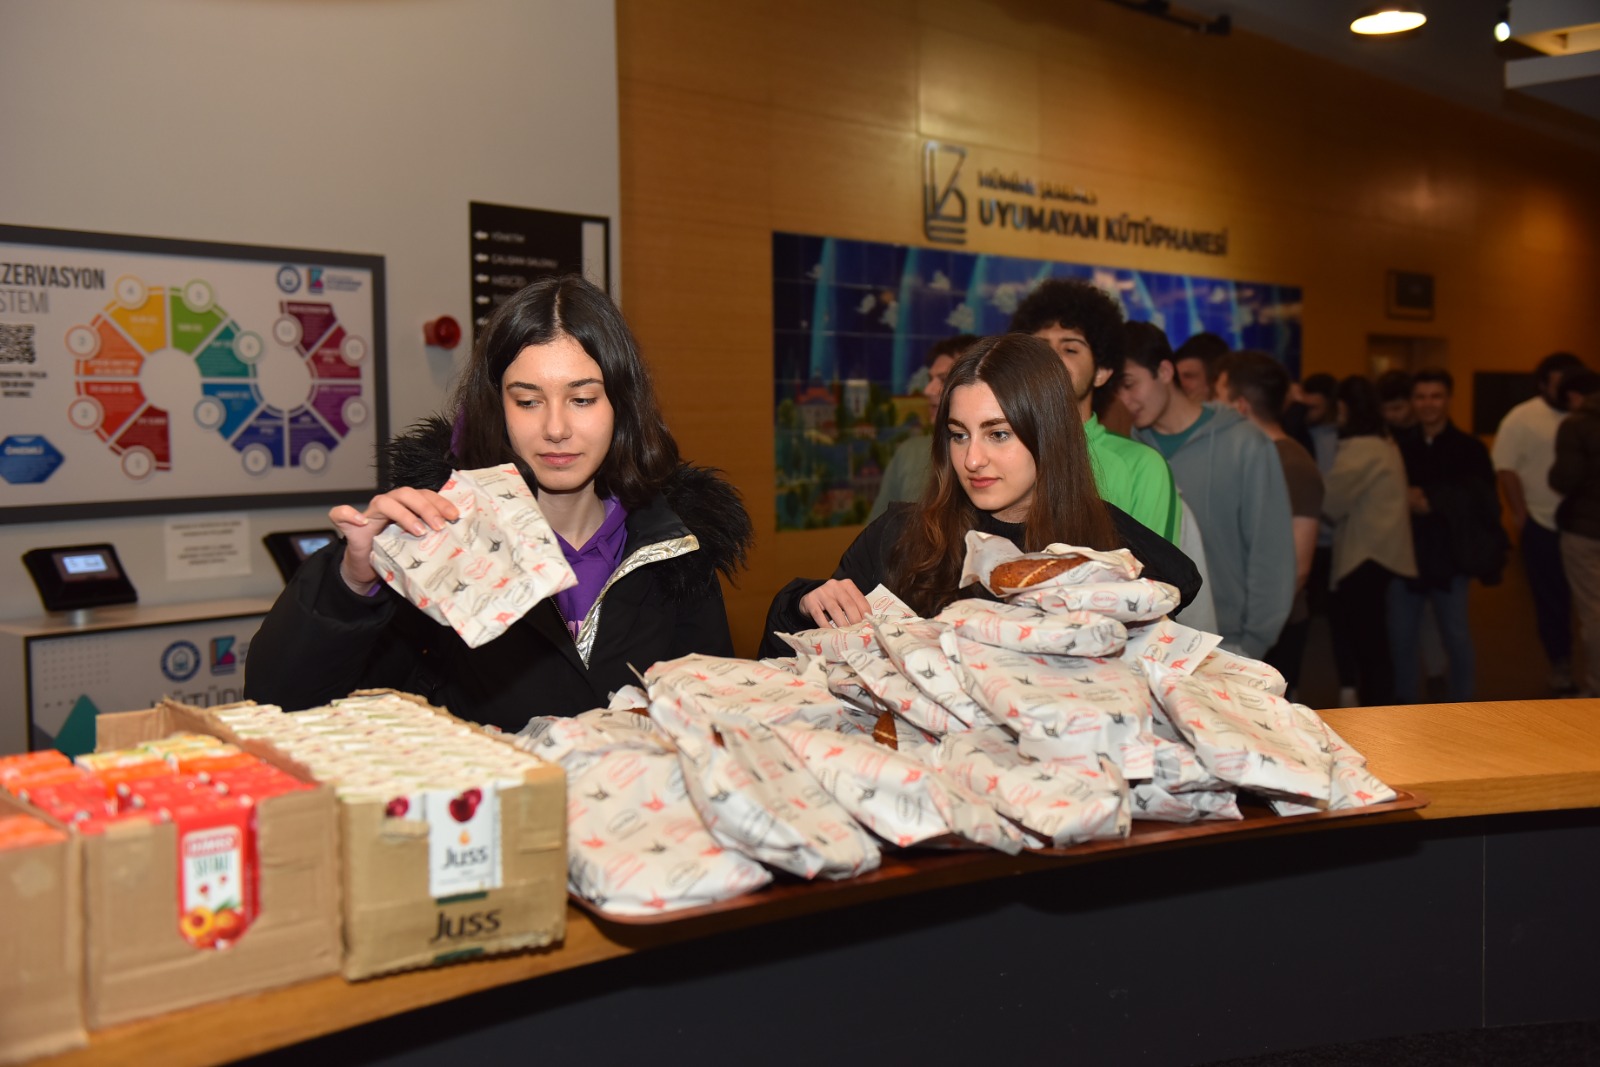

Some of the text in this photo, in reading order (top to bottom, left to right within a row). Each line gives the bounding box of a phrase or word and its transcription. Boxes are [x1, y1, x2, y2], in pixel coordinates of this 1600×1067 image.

[978, 197, 1228, 256] UYUMAYAN KÜTÜPHANESİ
[0, 263, 105, 290] ZERVASYON
[440, 846, 489, 869] Juss
[428, 908, 503, 944] Juss
